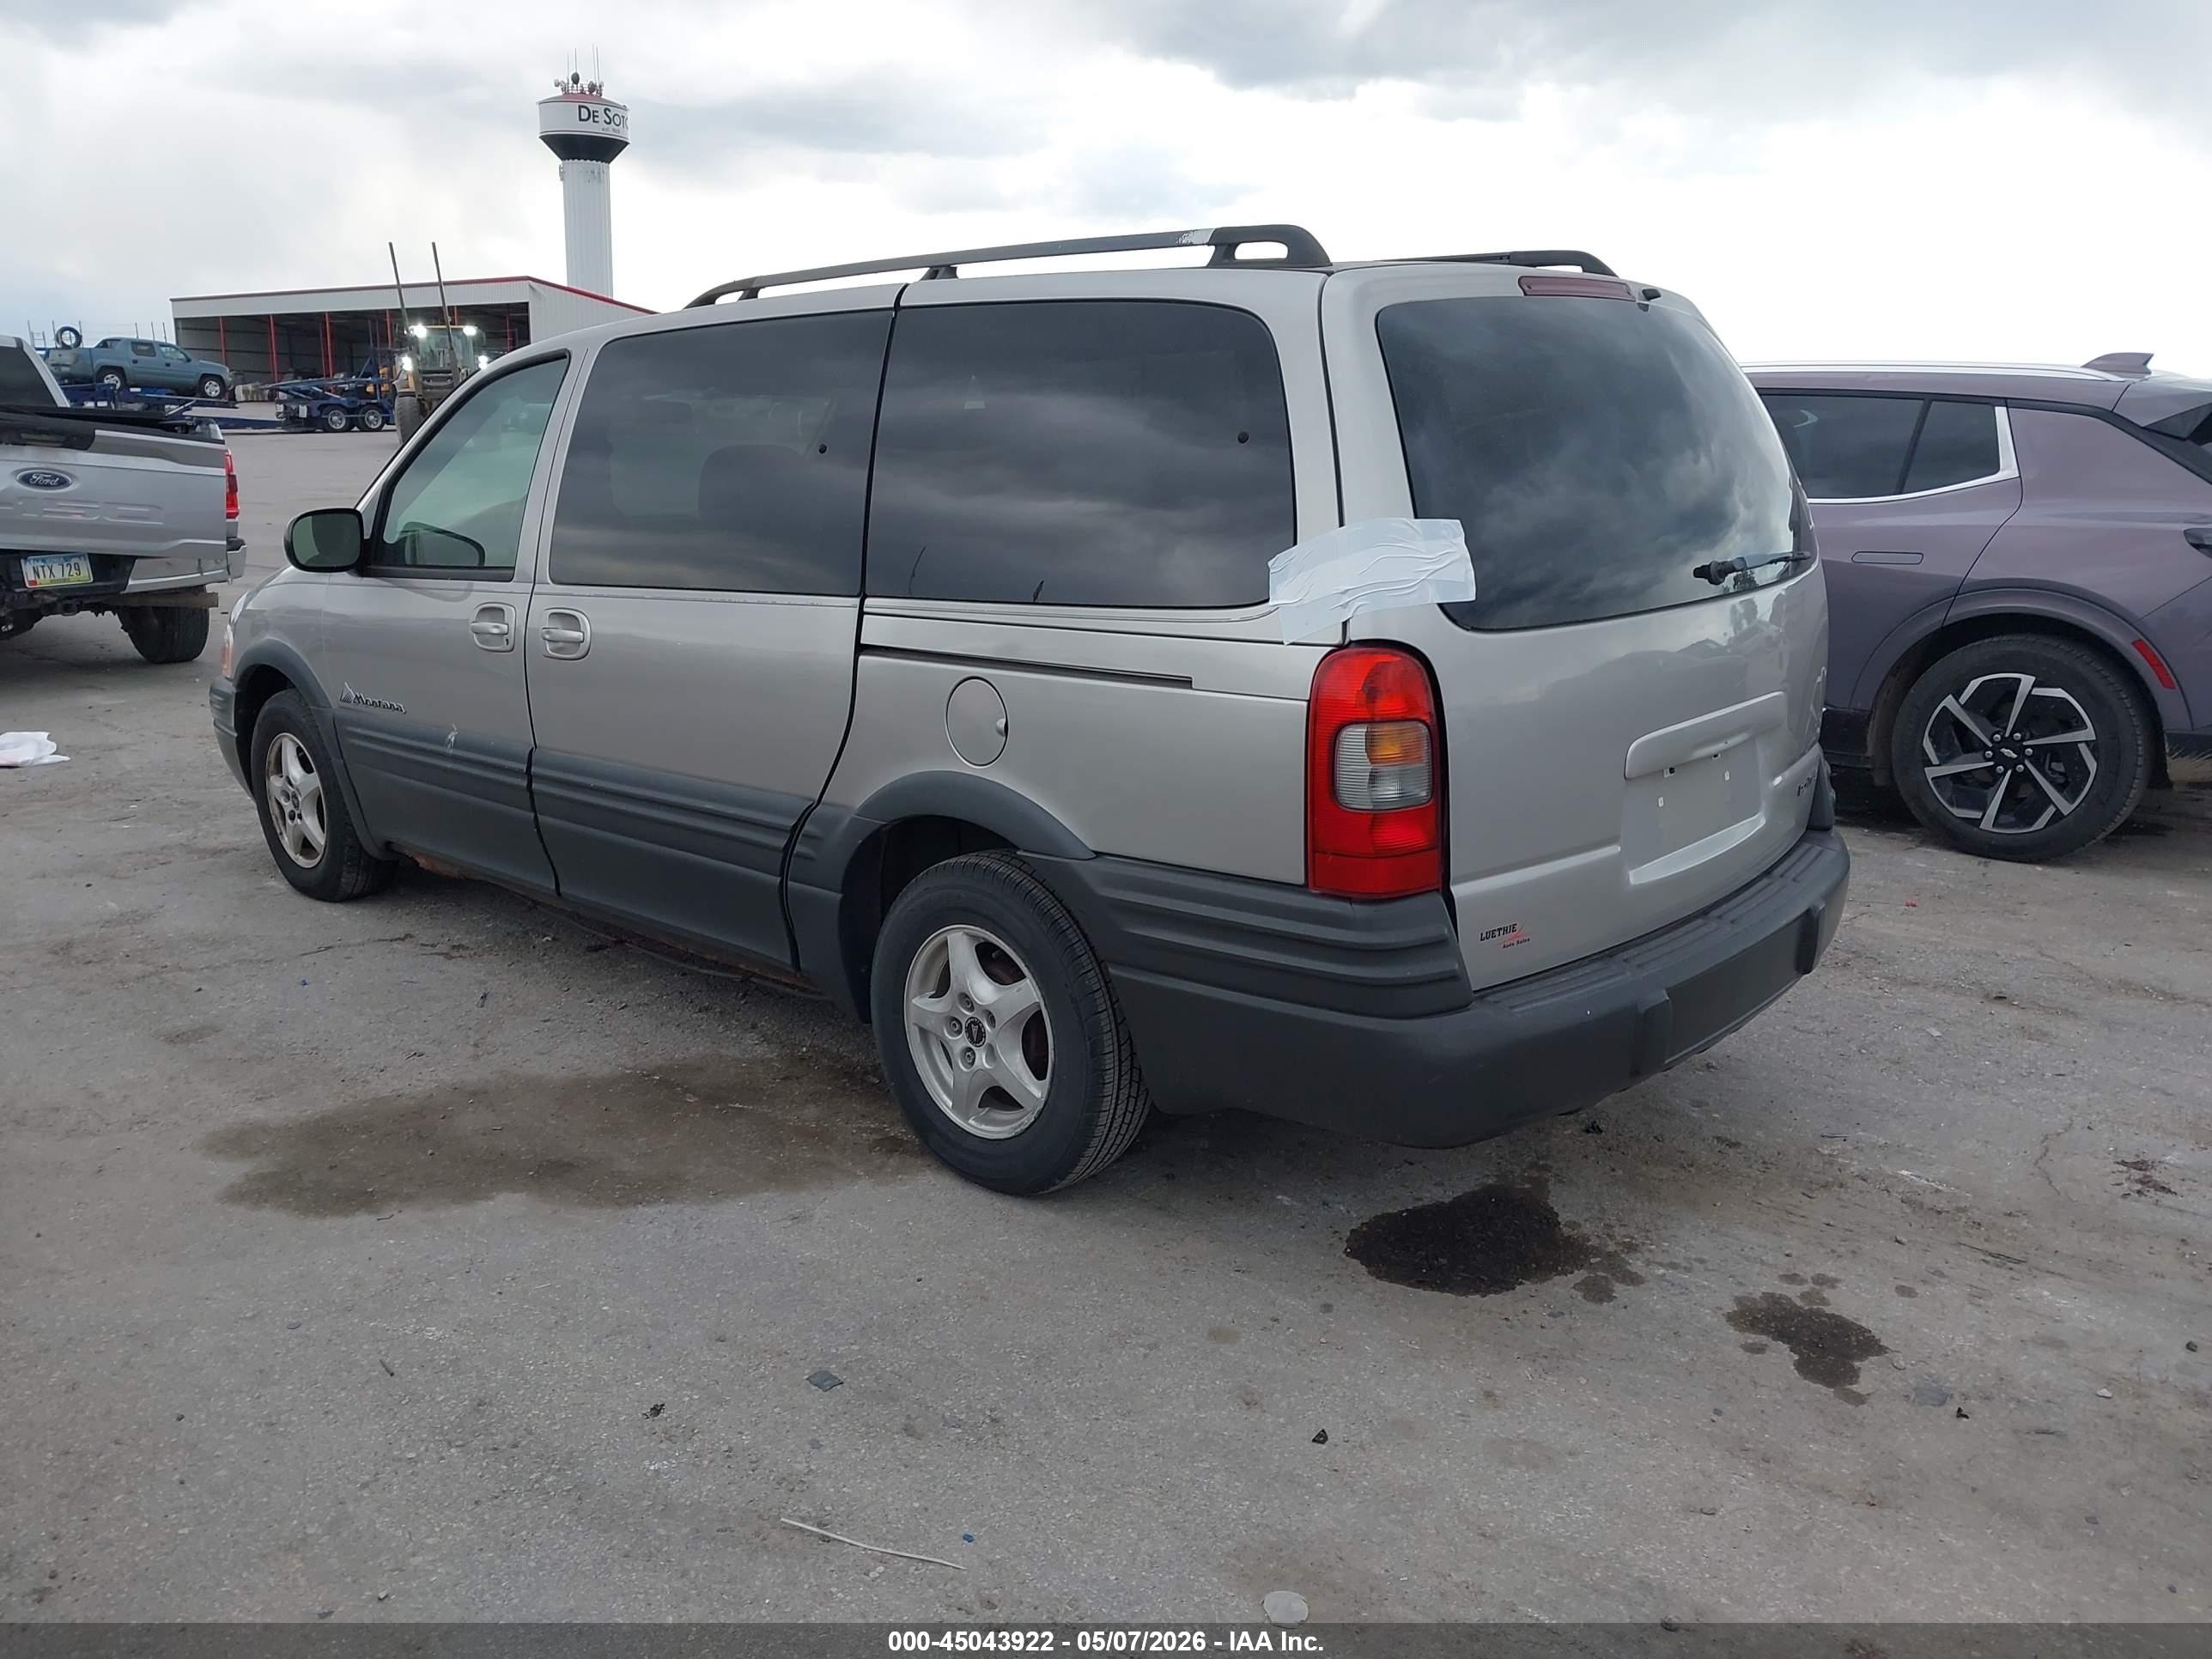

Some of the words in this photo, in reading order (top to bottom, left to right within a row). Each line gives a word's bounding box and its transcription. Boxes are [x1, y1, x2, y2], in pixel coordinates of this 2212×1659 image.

[29, 472, 59, 486] Ford
[32, 563, 56, 580] NTX
[58, 562, 82, 578] 729
[353, 692, 407, 714] Montana
